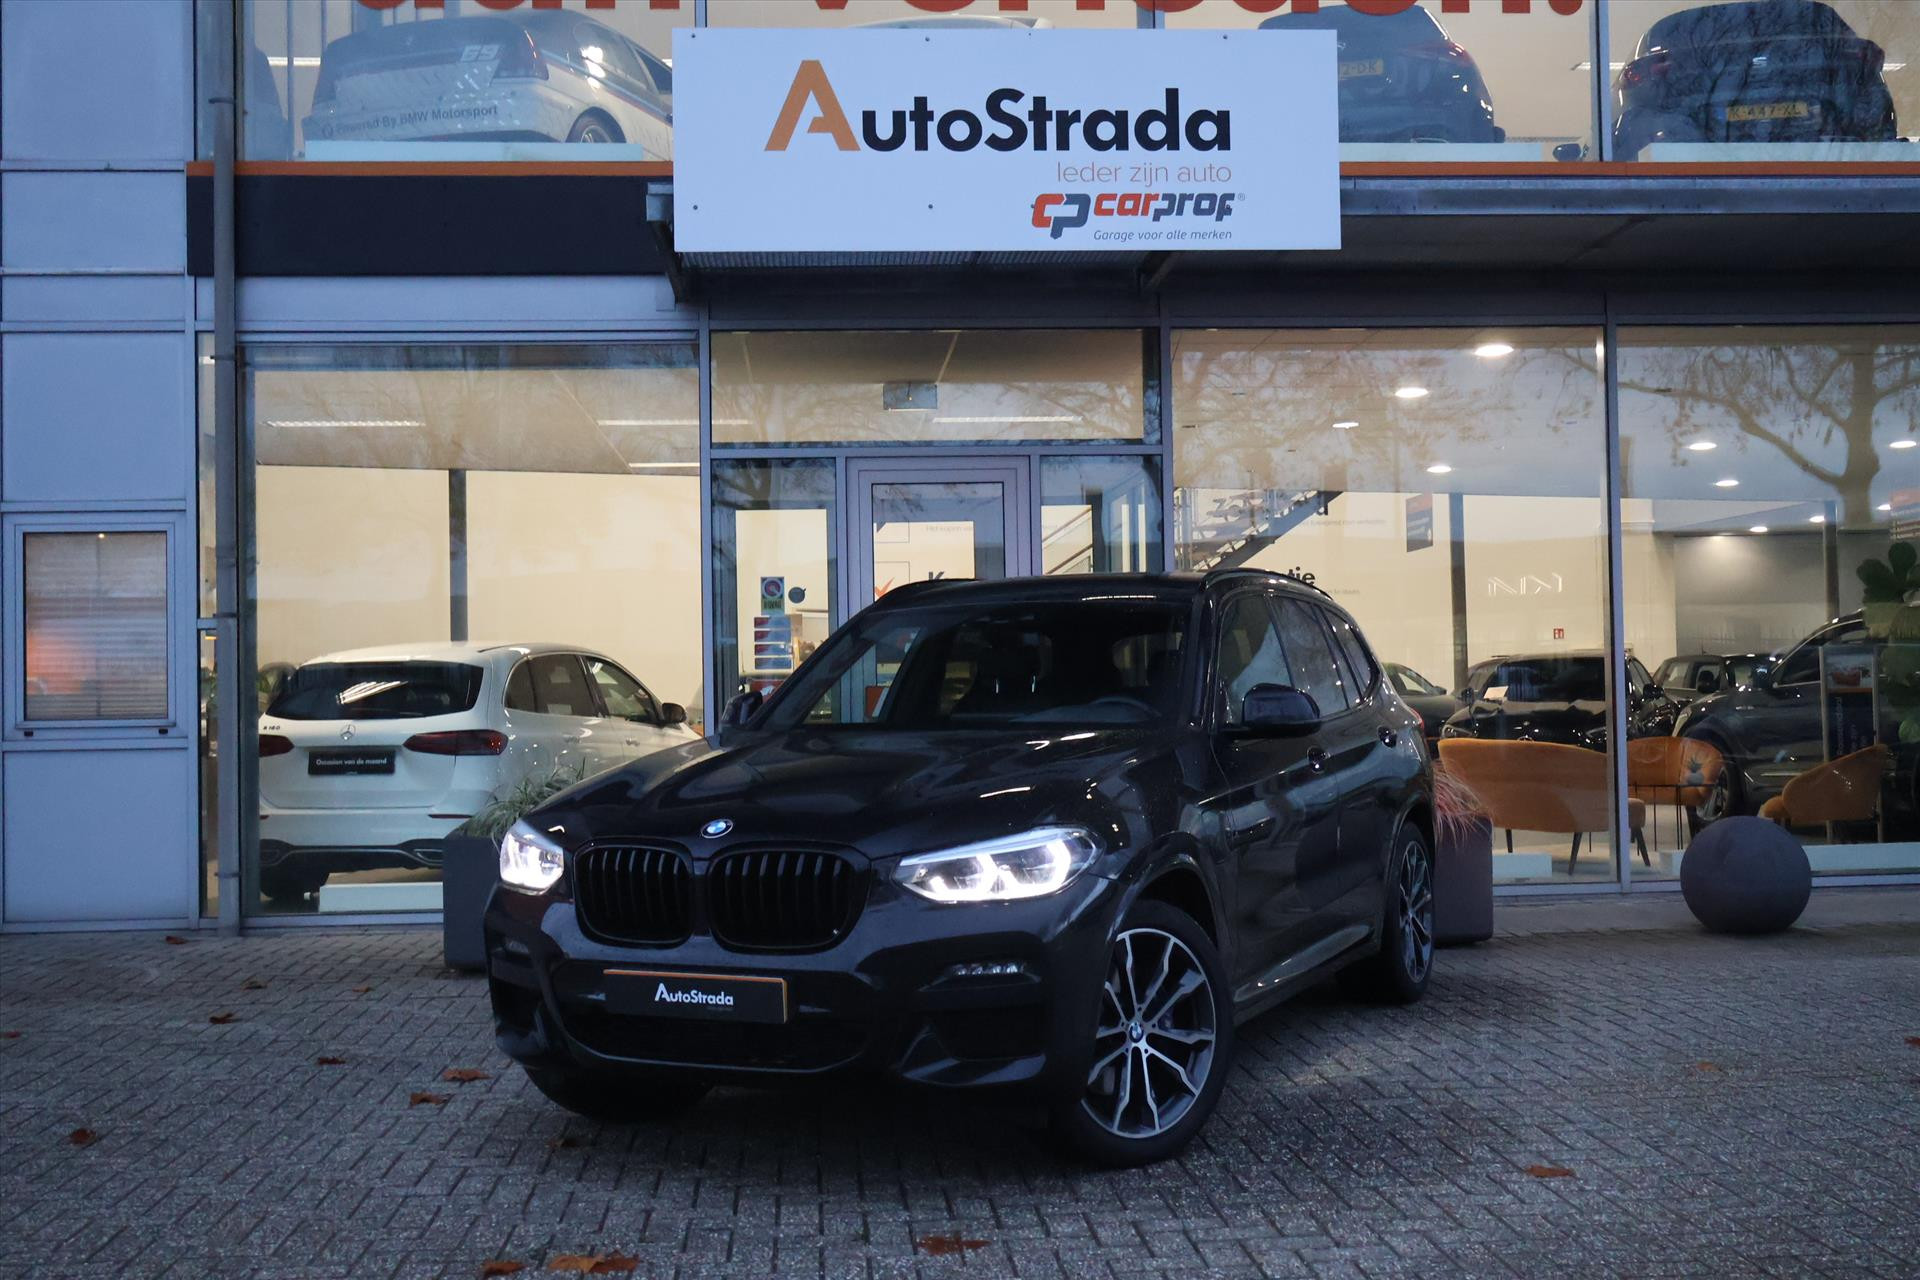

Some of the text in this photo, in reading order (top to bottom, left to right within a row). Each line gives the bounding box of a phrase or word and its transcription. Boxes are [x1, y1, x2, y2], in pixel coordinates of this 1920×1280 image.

[383, 115, 397, 129] By
[400, 111, 429, 126] BMW
[431, 105, 498, 122] Motorsport
[764, 59, 1231, 153] AutoStrada
[1057, 161, 1232, 188] Ieder zijn auto
[1093, 193, 1236, 222] carprof
[1093, 230, 1232, 243] Garage voor alle merken
[356, 757, 364, 765] de
[654, 982, 734, 1006] AutoStrada
